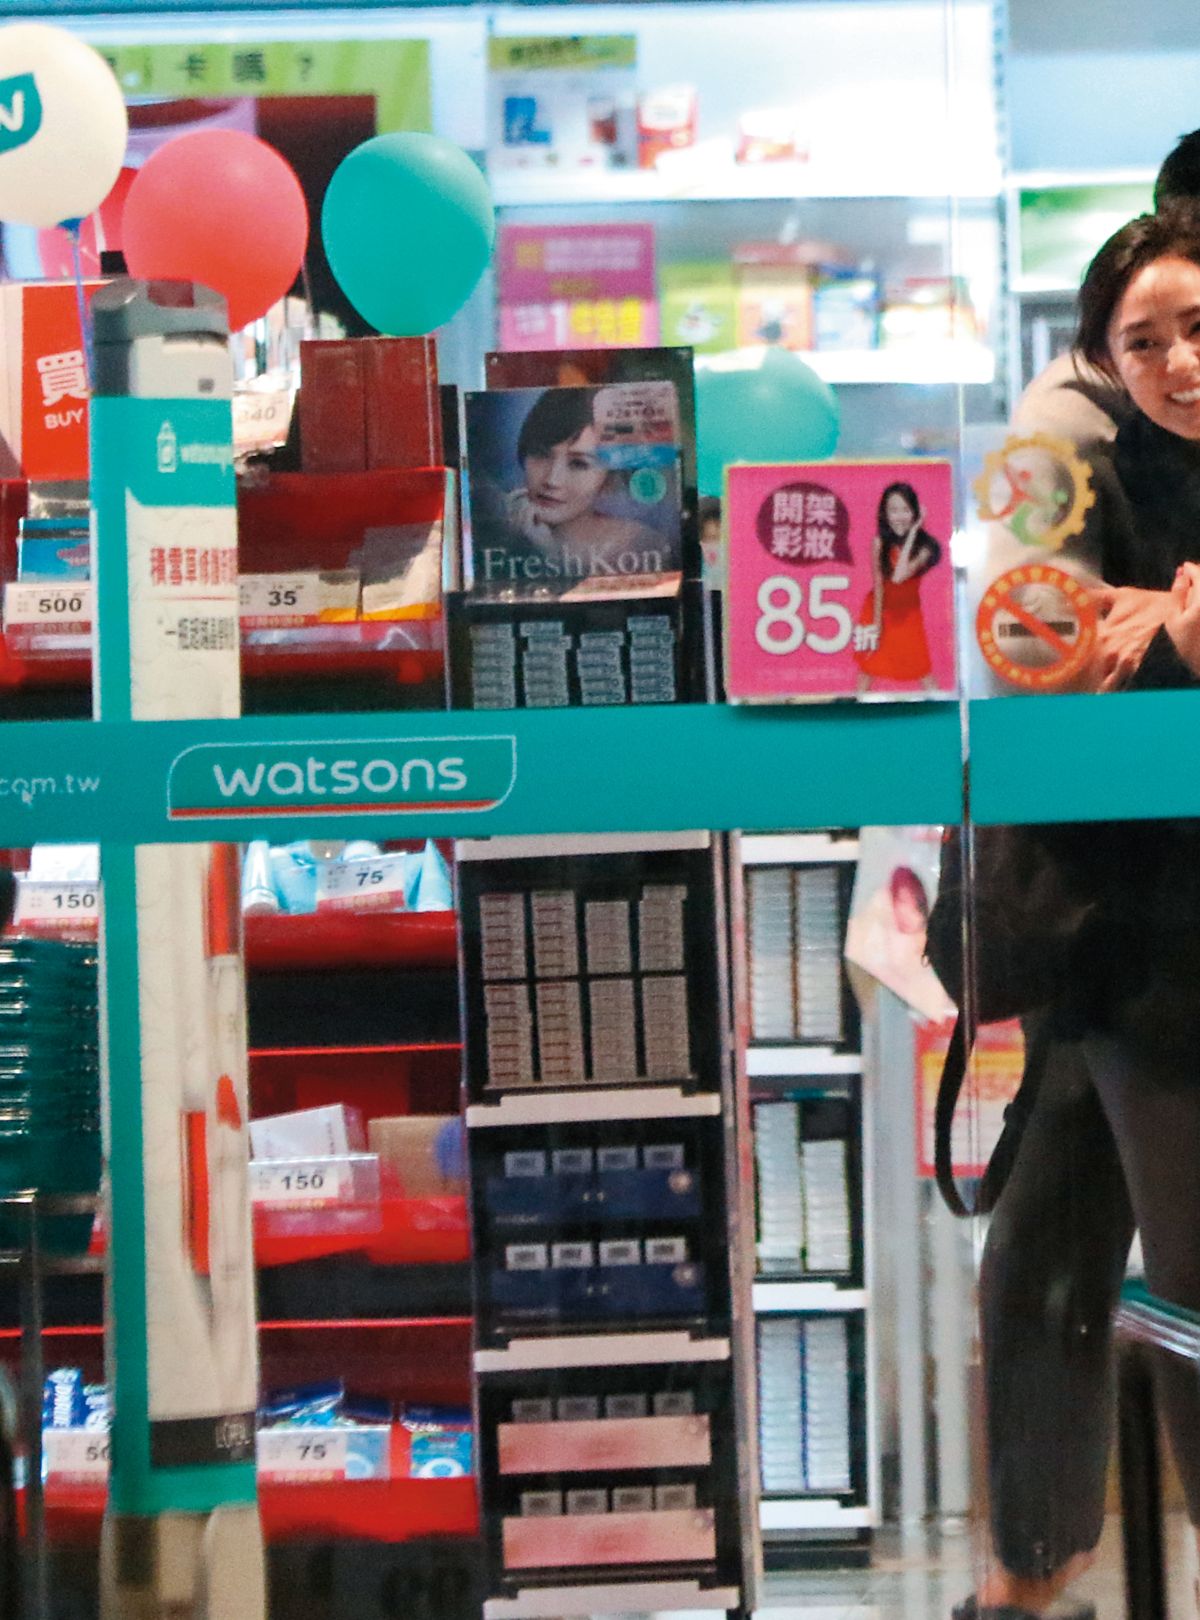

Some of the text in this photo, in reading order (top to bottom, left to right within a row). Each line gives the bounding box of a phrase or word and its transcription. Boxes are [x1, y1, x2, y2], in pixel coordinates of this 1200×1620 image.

[44, 408, 85, 430] BUY
[772, 491, 837, 526] 開架
[39, 597, 83, 613] 500
[268, 590, 297, 607] 35
[213, 755, 467, 798] watsons
[355, 870, 384, 887] 75
[53, 893, 96, 909] 150
[281, 1174, 324, 1190] 150
[297, 1444, 327, 1461] 75
